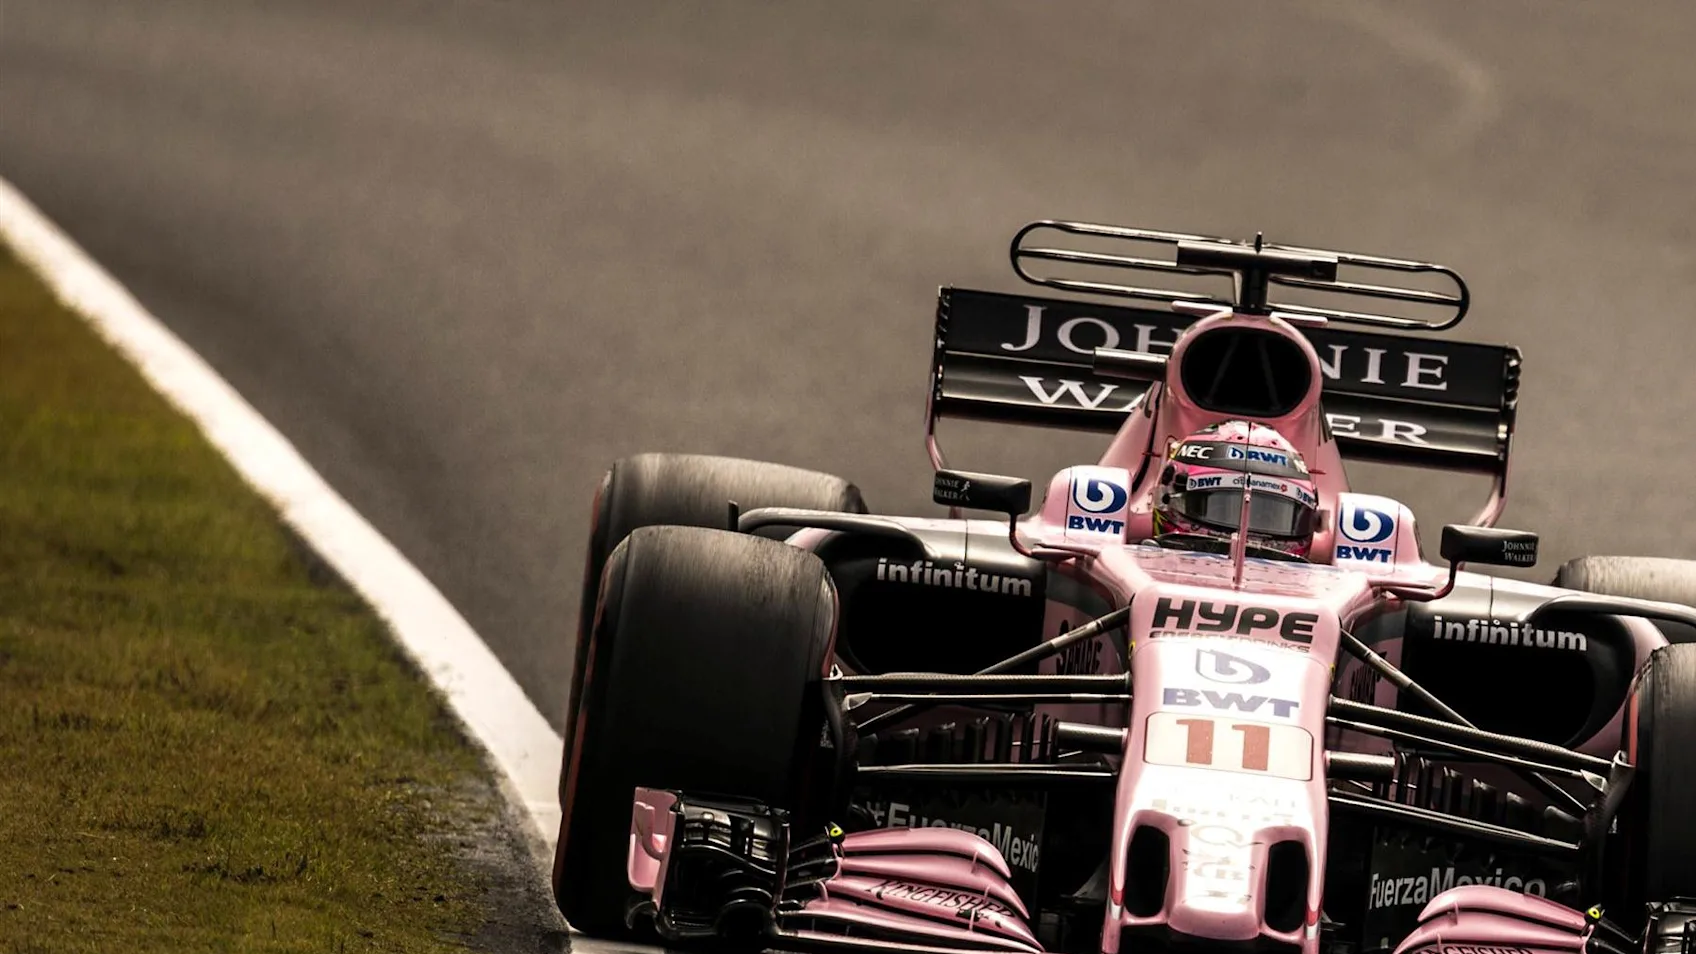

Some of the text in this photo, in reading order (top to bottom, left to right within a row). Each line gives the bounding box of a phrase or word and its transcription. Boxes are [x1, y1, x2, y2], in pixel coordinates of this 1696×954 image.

[1001, 304, 1448, 390] JOHNIE
[1018, 375, 1430, 445] WER
[1177, 445, 1213, 459] NEC
[1246, 450, 1288, 467] BWT
[1197, 477, 1222, 488] BWT
[1232, 476, 1281, 490] citianamex
[1068, 515, 1125, 535] BWT
[1336, 545, 1392, 563] BWT
[876, 557, 1032, 597] infinitum
[1152, 597, 1319, 645] HYPE
[1433, 615, 1588, 652] infinitum
[1163, 687, 1300, 719] BWT
[1175, 718, 1271, 772] 11
